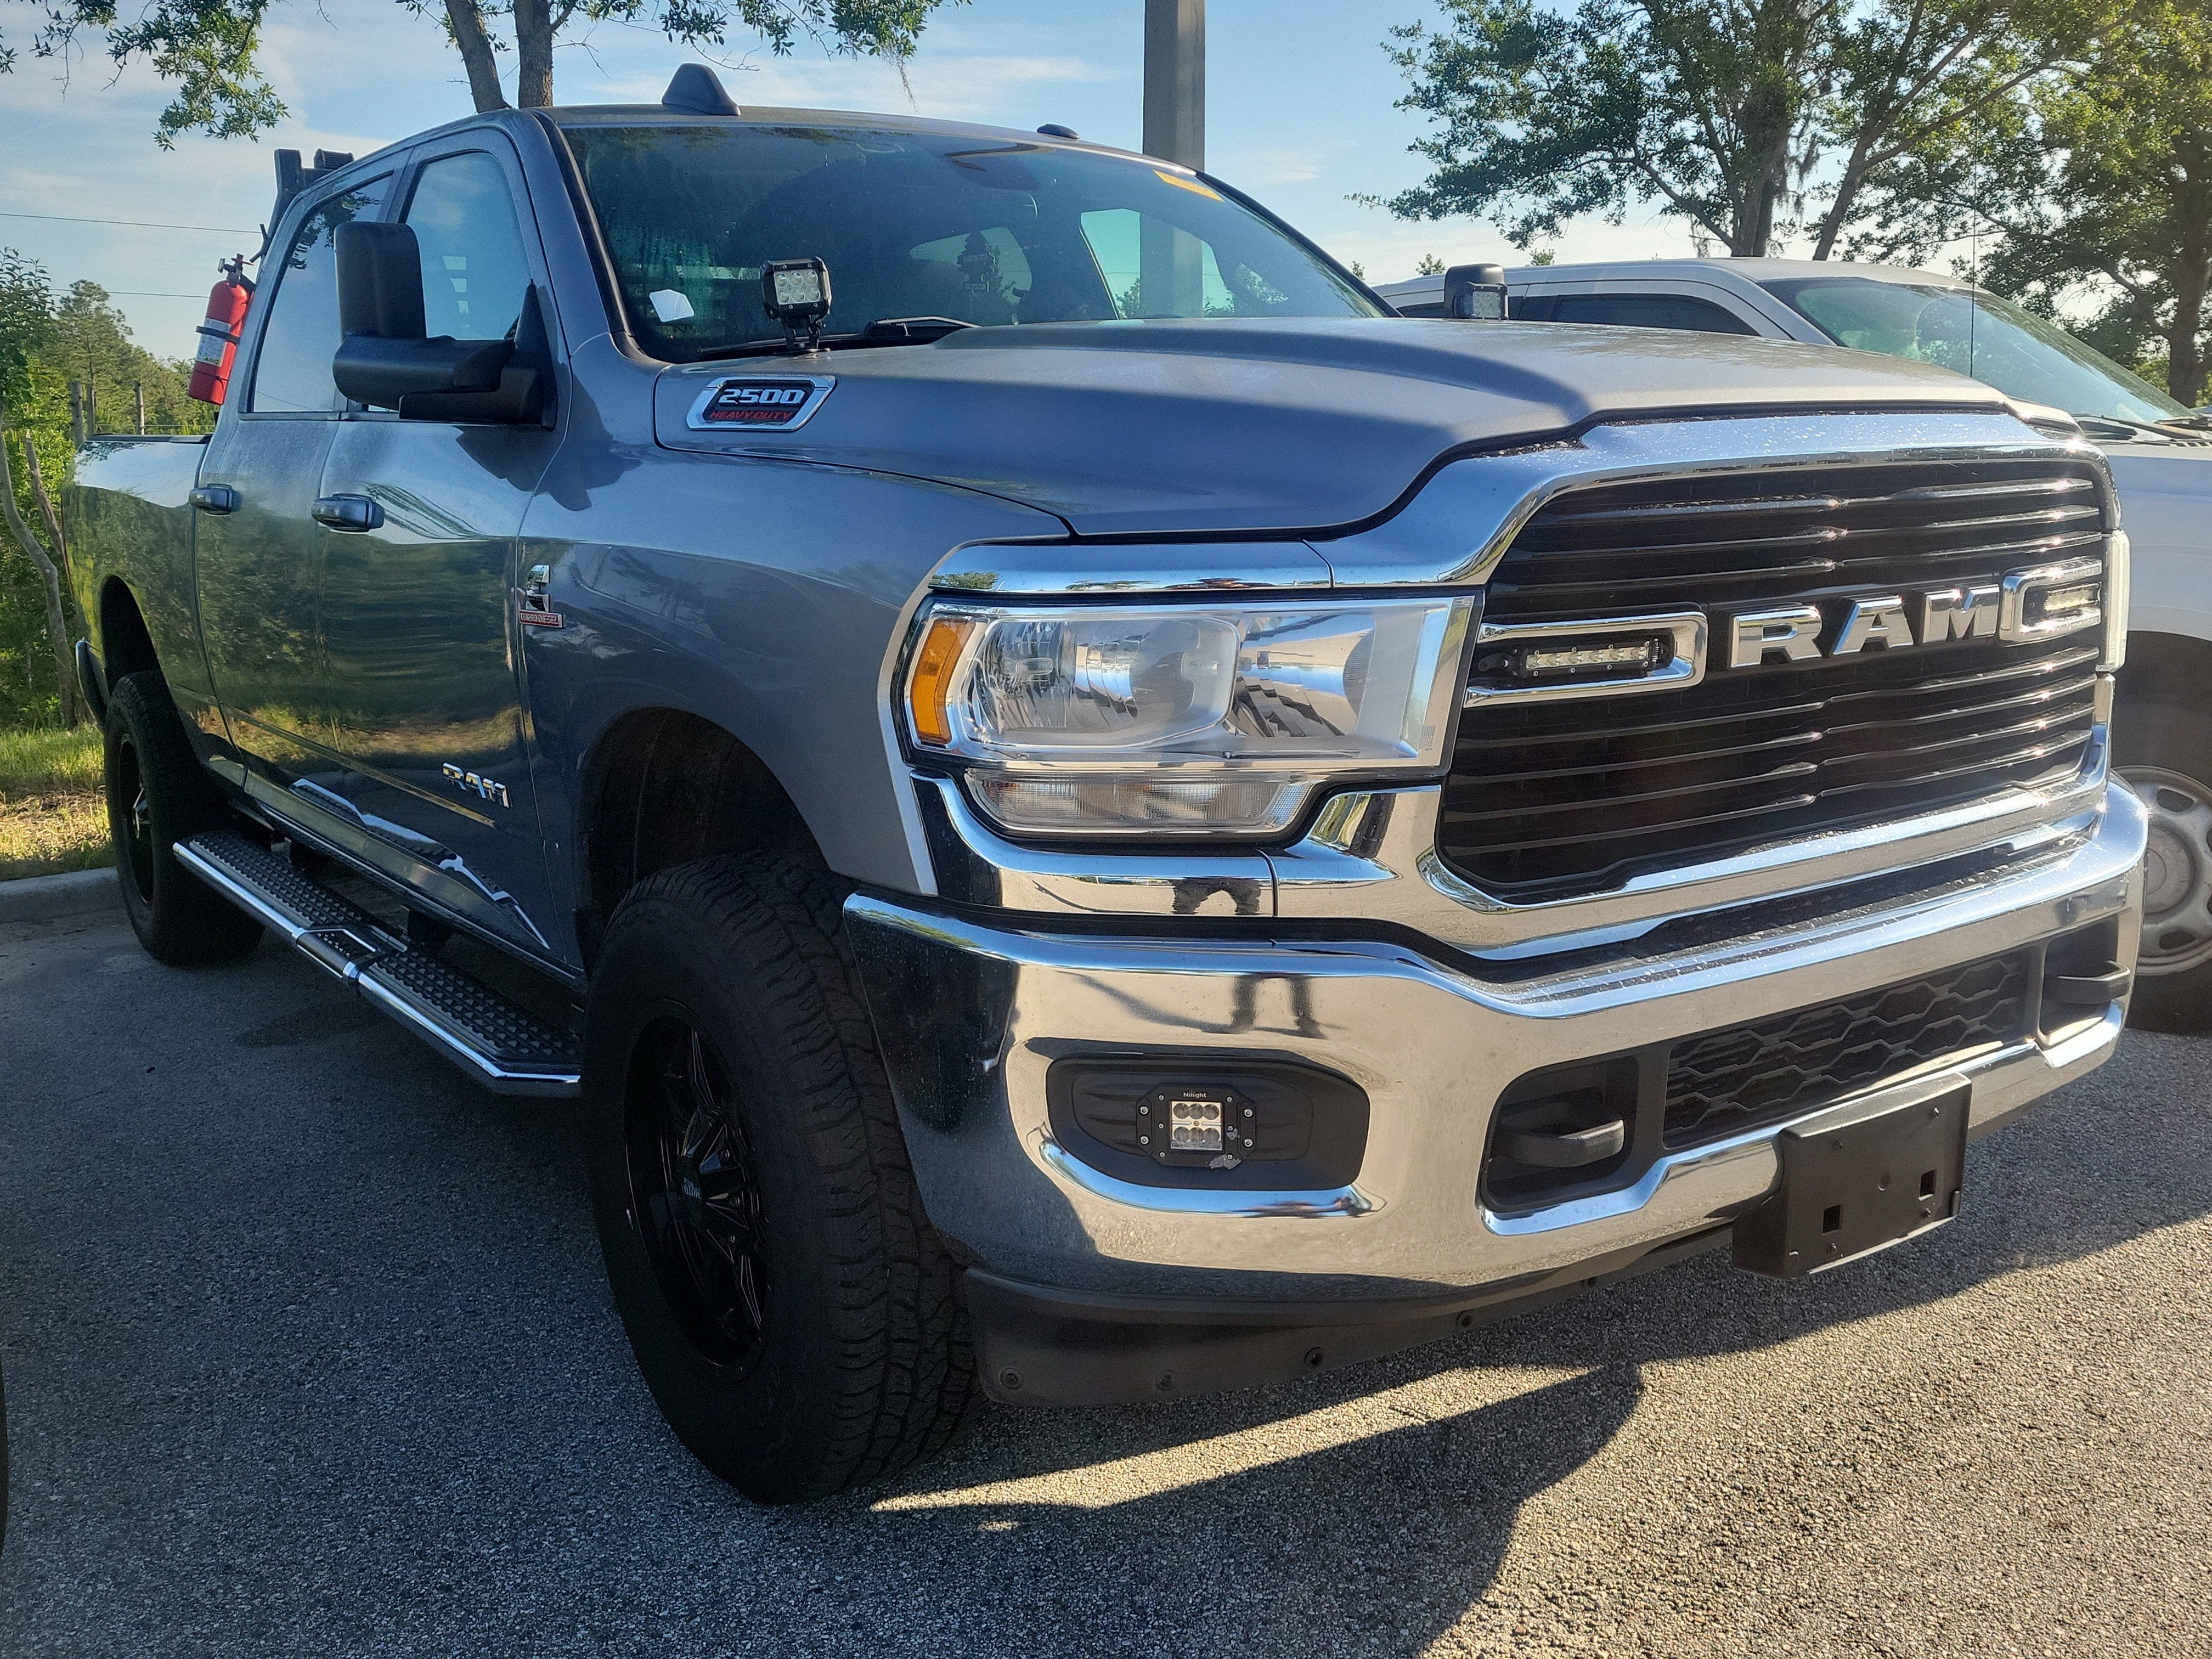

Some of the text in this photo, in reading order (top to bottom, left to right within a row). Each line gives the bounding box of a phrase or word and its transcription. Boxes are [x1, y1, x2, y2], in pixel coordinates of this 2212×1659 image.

[718, 388, 806, 405] 2500
[709, 410, 792, 419] HEAVY DUTY
[1730, 583, 2000, 668] RAM
[1183, 1090, 1207, 1099] Nilight
